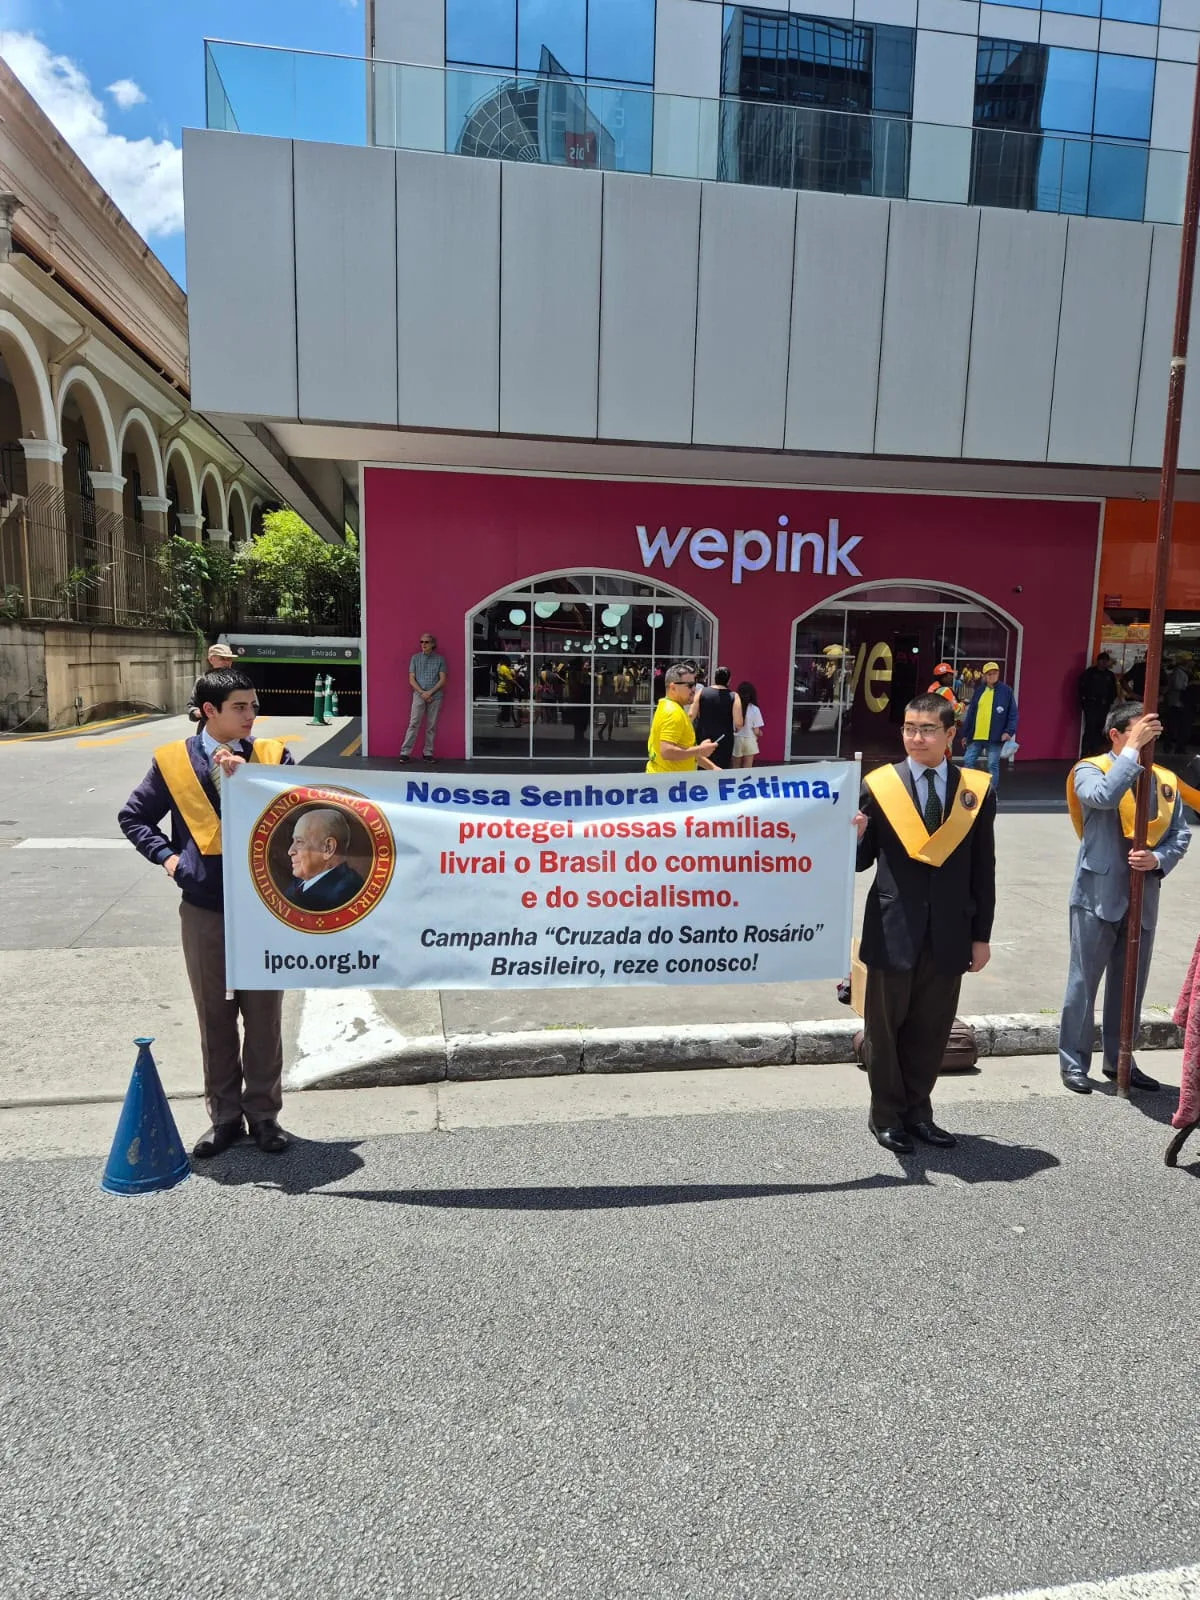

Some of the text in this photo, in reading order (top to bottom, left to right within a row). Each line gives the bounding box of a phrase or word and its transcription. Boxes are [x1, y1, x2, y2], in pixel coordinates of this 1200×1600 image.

[635, 514, 864, 584] wepink
[311, 648, 337, 657] Entrada
[406, 775, 840, 807] Nossa Senhora de Fátima,
[257, 792, 300, 836] PLINIO
[369, 818, 386, 841] DE
[459, 814, 797, 844] protegei nossas famílias,
[439, 849, 812, 874] livrai o Brasil do comunismo
[252, 839, 292, 919] INSTITUTO
[348, 846, 390, 916] OLIVEIRA
[521, 884, 740, 909] e do socialismo.
[420, 923, 825, 951] Campanha “Cruzada do Santo Rosário”
[264, 950, 380, 974] ipco.org.br
[490, 953, 759, 979] Brasileiro, reze conosco!
